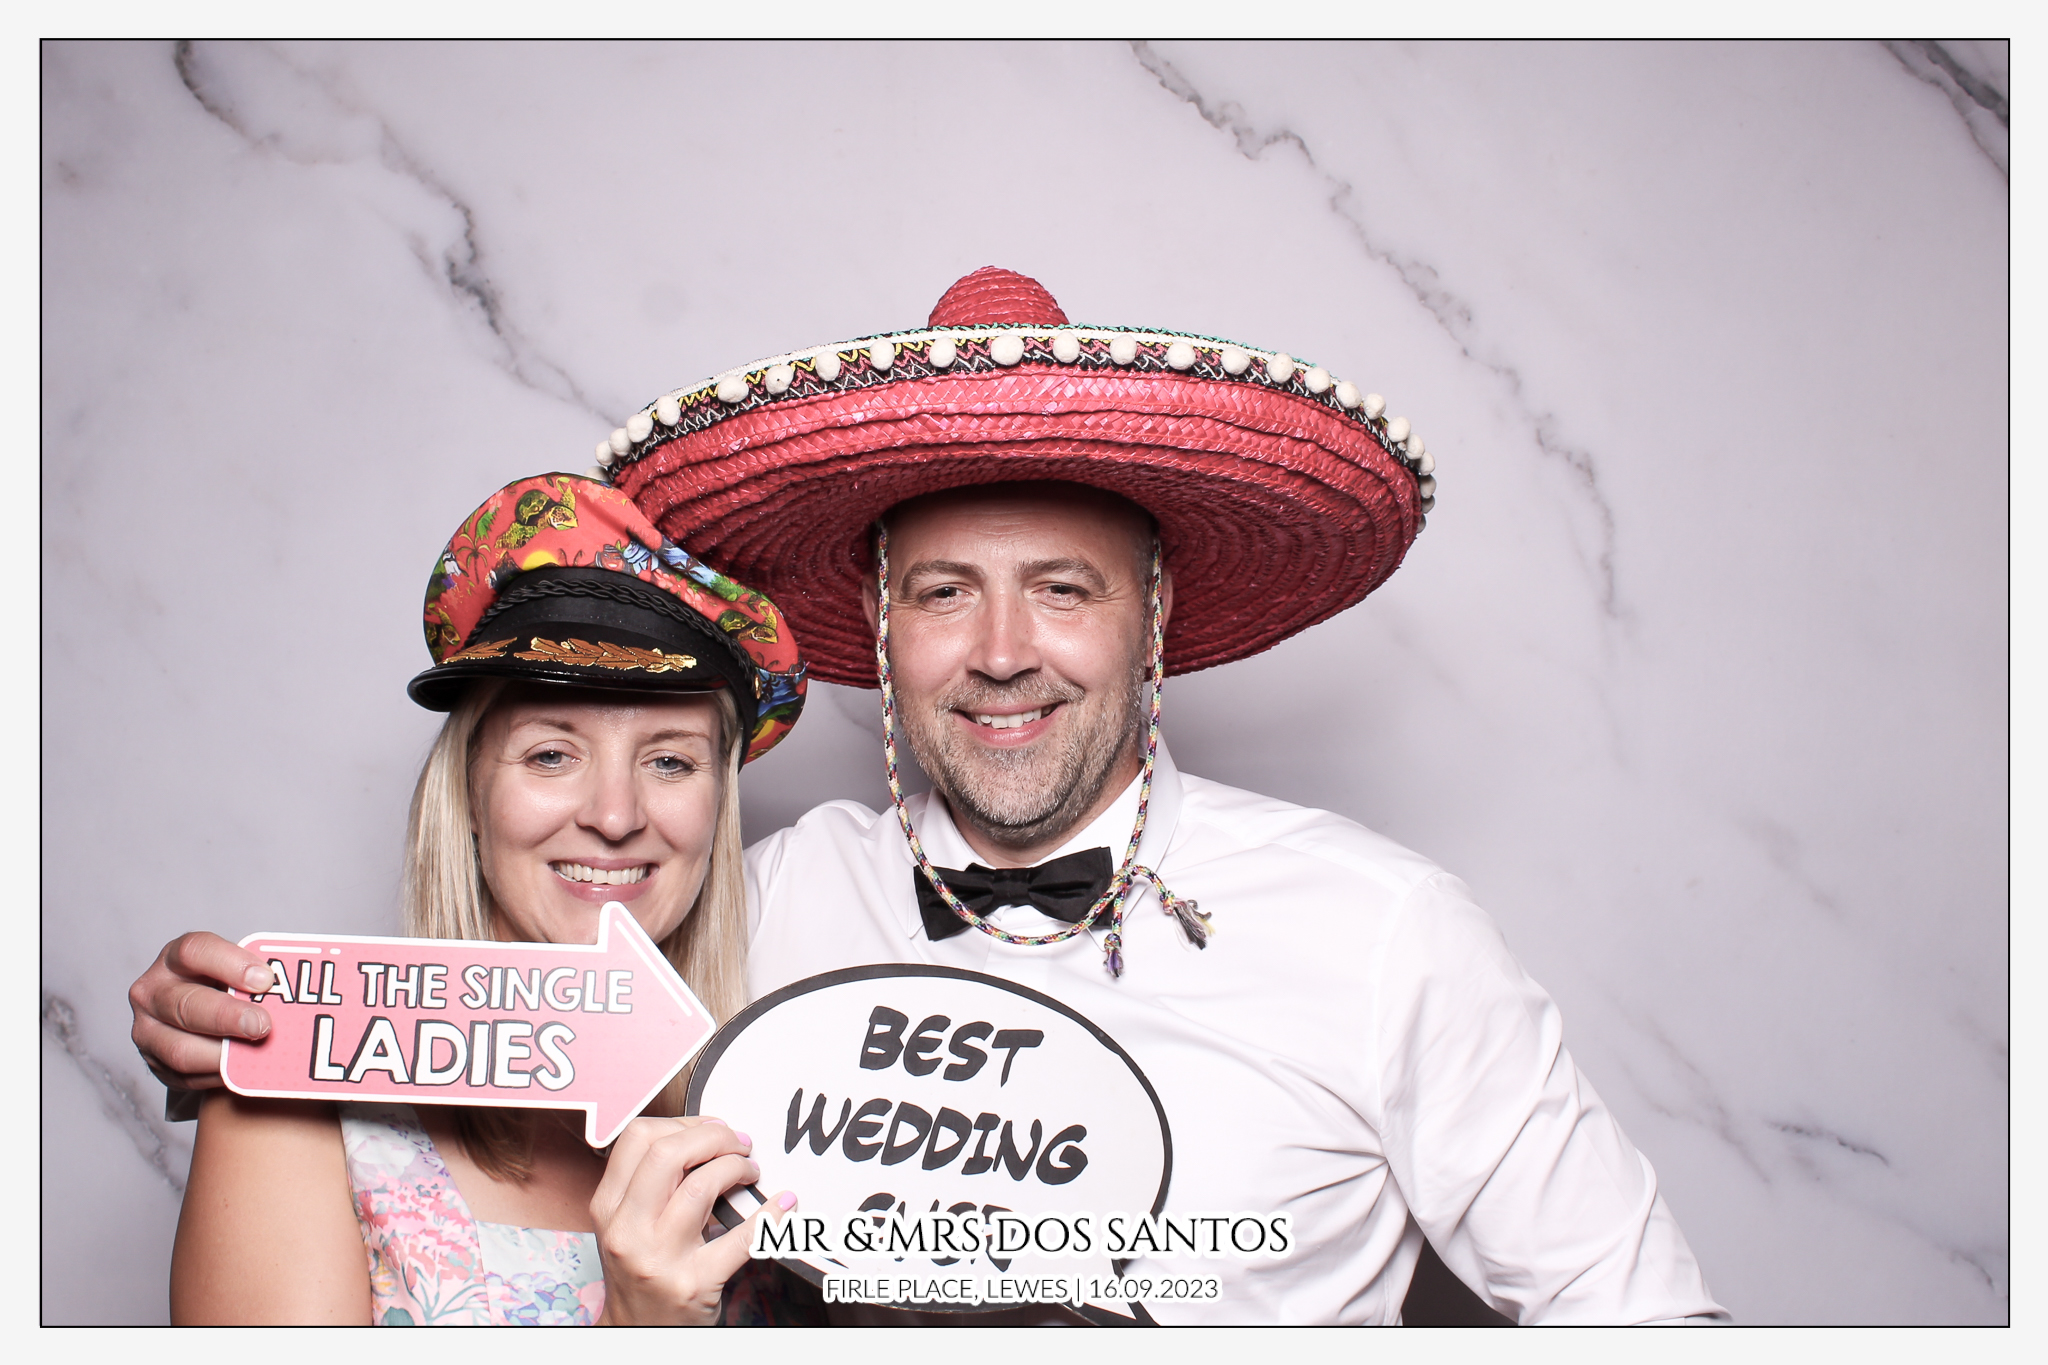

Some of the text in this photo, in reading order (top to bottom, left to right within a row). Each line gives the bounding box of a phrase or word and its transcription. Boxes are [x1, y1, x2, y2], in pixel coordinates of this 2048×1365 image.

[250, 958, 634, 1014] ALL THE SINGLE
[309, 1014, 577, 1091] LADIES
[859, 1005, 1045, 1087] BEST
[784, 1087, 1089, 1185] WEDDING
